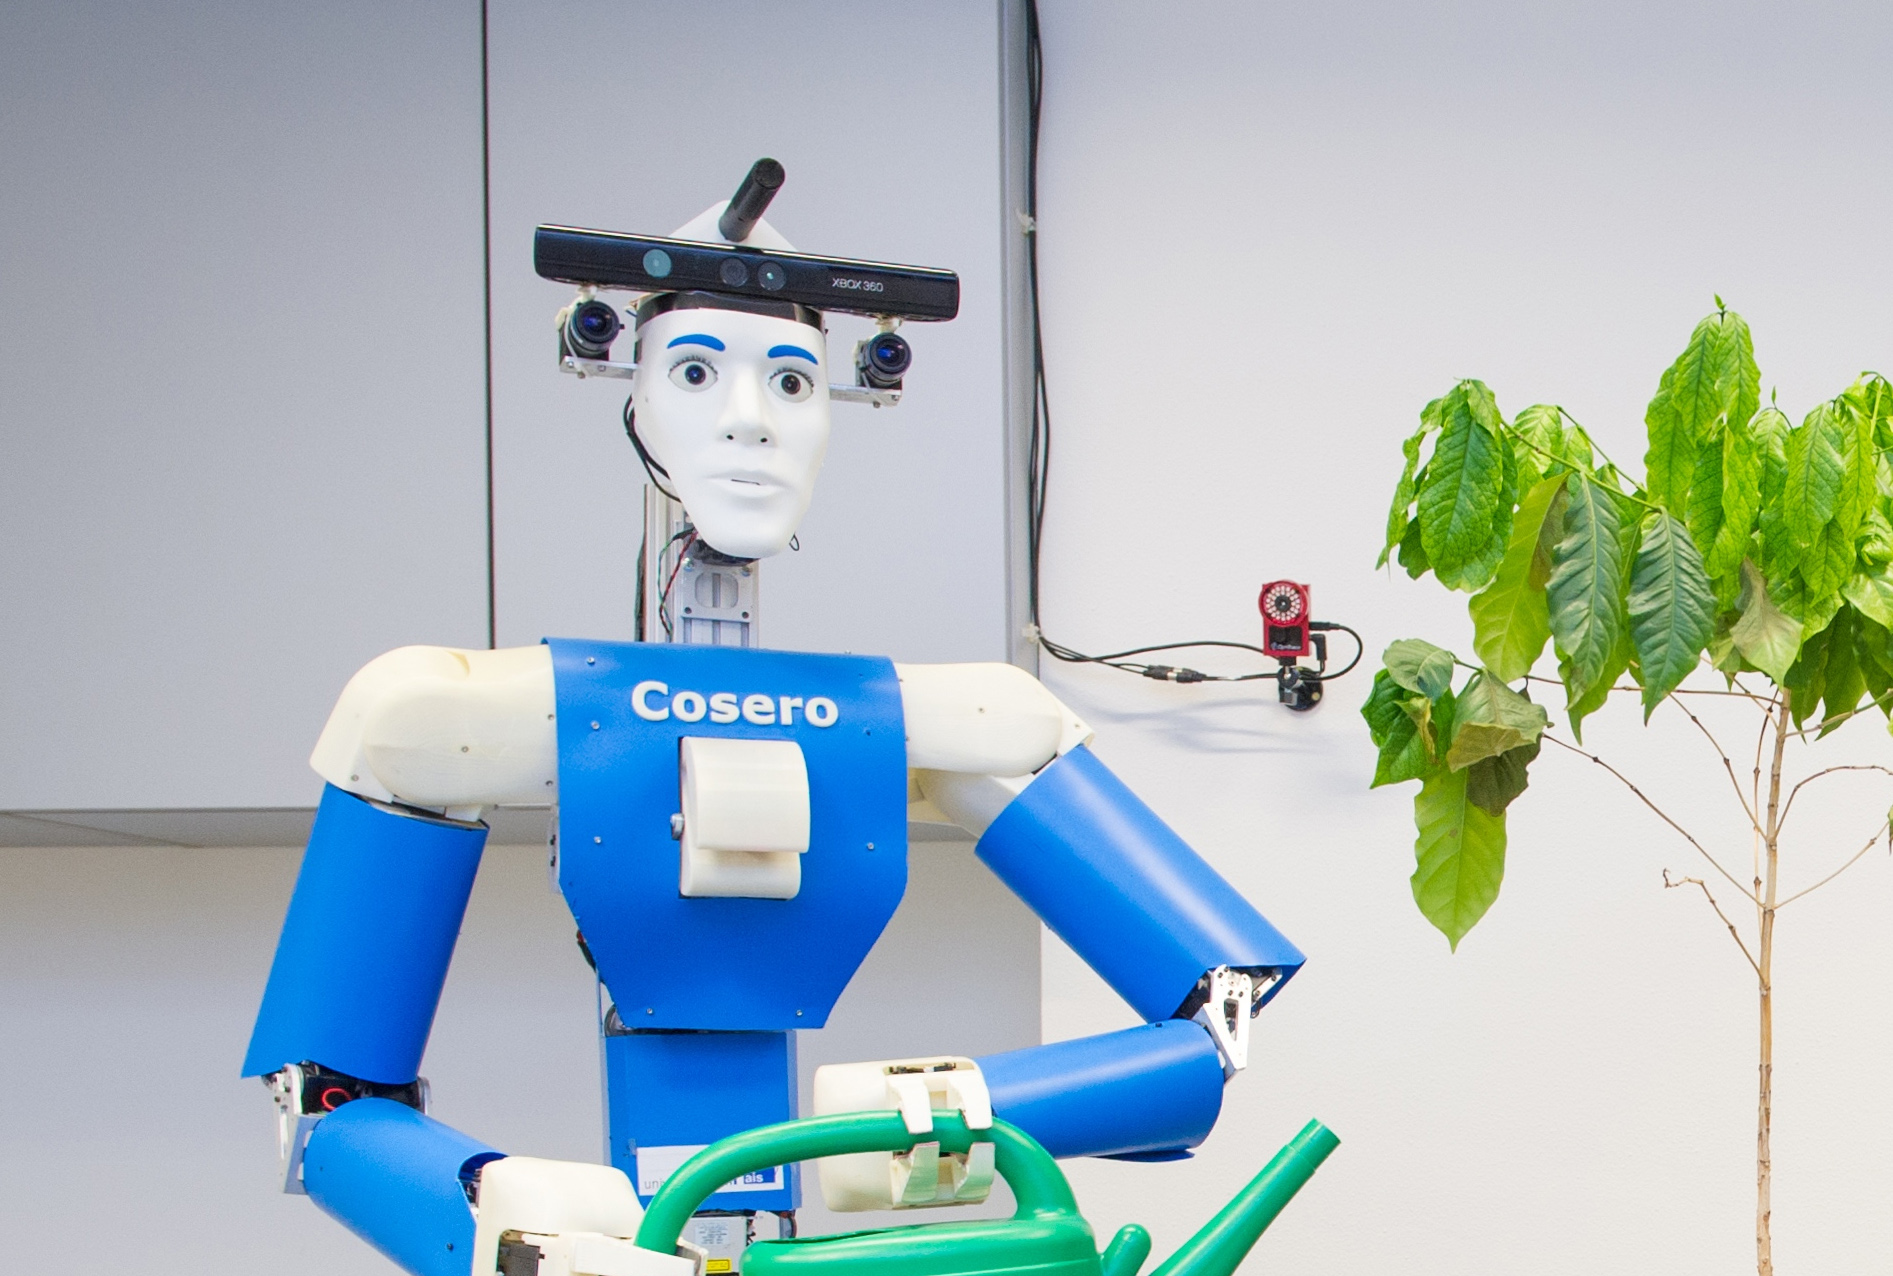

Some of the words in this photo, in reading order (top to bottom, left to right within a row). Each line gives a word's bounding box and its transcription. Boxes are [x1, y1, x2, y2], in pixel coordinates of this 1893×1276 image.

[832, 278, 862, 290] XBOX
[863, 280, 884, 292] 360
[631, 680, 839, 728] Cosero
[745, 1171, 764, 1183] ais
